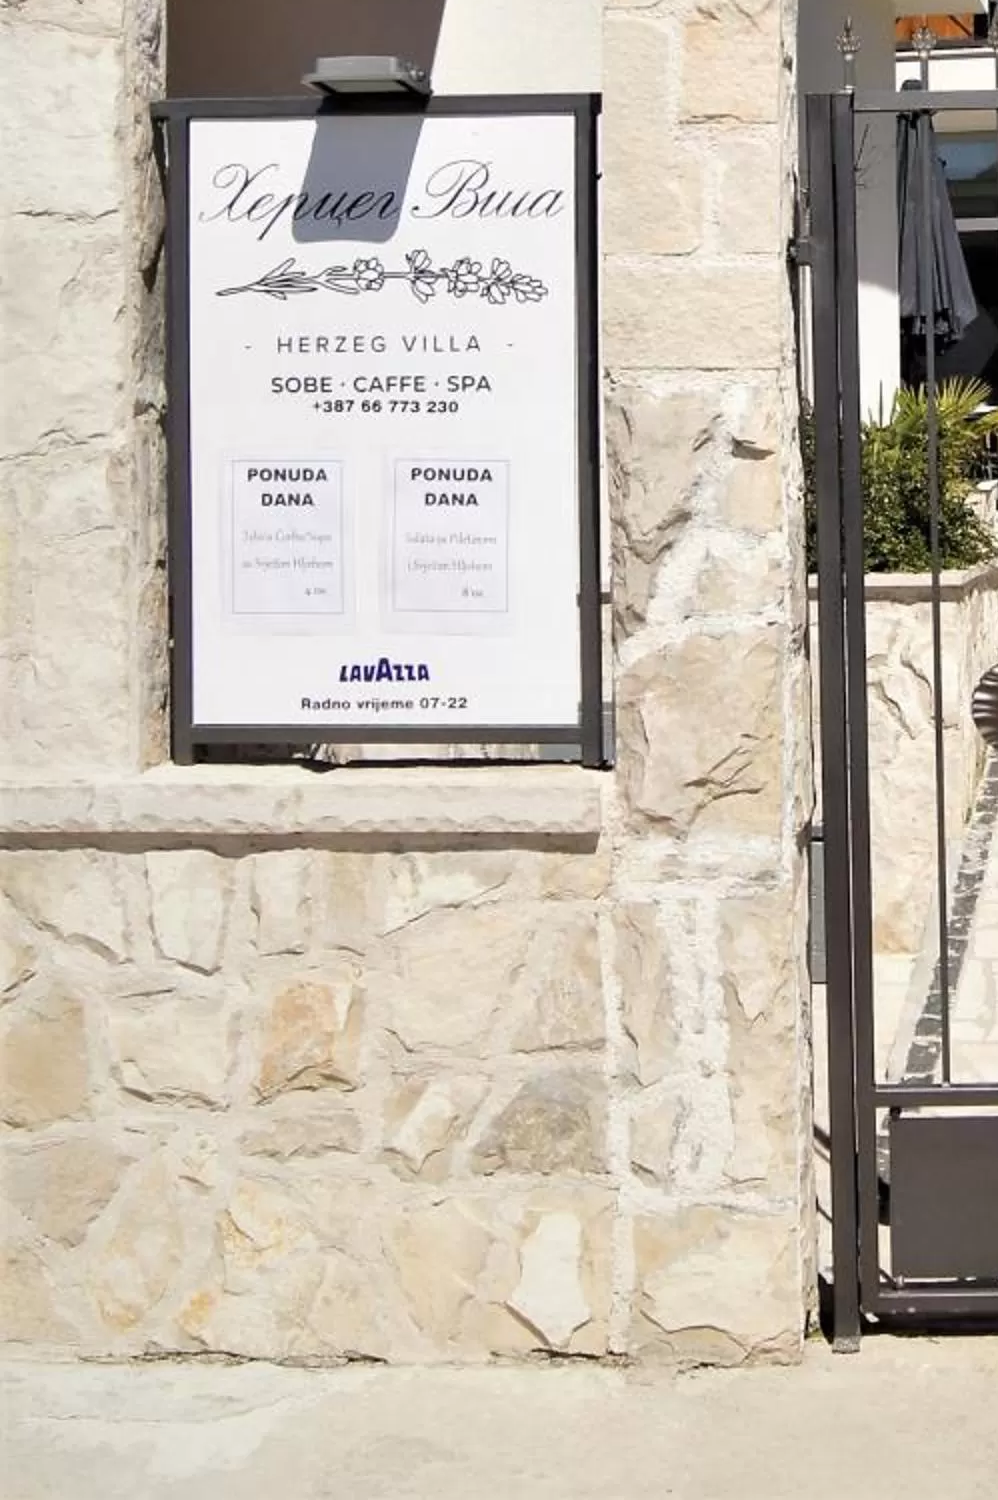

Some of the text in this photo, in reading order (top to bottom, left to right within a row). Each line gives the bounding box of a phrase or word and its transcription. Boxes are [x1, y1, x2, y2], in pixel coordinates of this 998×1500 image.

[198, 162, 402, 241] Херцег
[277, 334, 481, 354] HERZEG VILLA
[271, 374, 492, 395] SOBE CAFFE SPA
[312, 399, 459, 414] +387 66 773 230
[247, 467, 328, 483] PONUDA
[410, 467, 493, 483] PONUDA
[260, 492, 316, 507] DANA
[424, 491, 480, 507] DANA
[338, 656, 431, 683] LAVAZZA
[300, 696, 468, 713] Radno vrijeme 07-22
